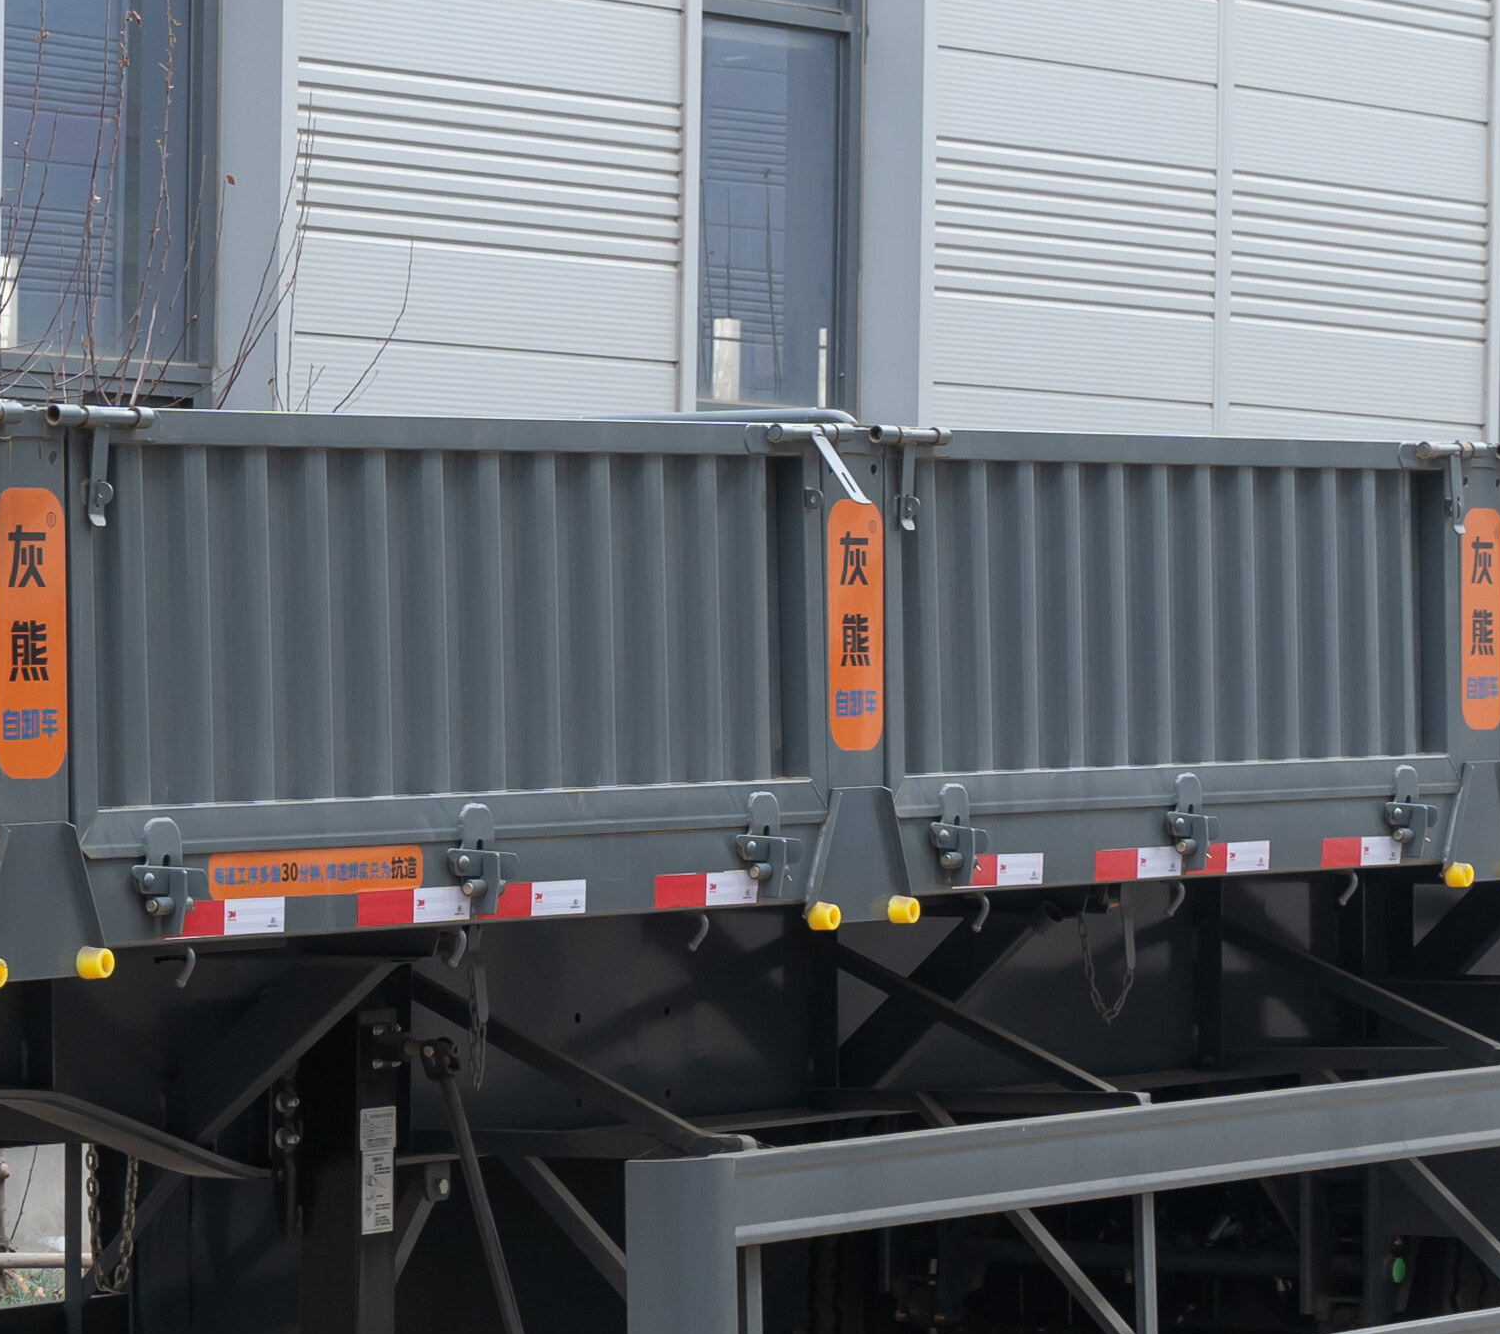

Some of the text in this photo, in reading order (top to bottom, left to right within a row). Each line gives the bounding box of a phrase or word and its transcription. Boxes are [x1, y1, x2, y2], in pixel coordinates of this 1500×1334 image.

[8, 525, 49, 682] 灰熊
[840, 531, 870, 667] 灰熊
[1471, 536, 1494, 656] 灰熊
[2, 708, 58, 740] 自卸车
[835, 689, 877, 717] 自卸车
